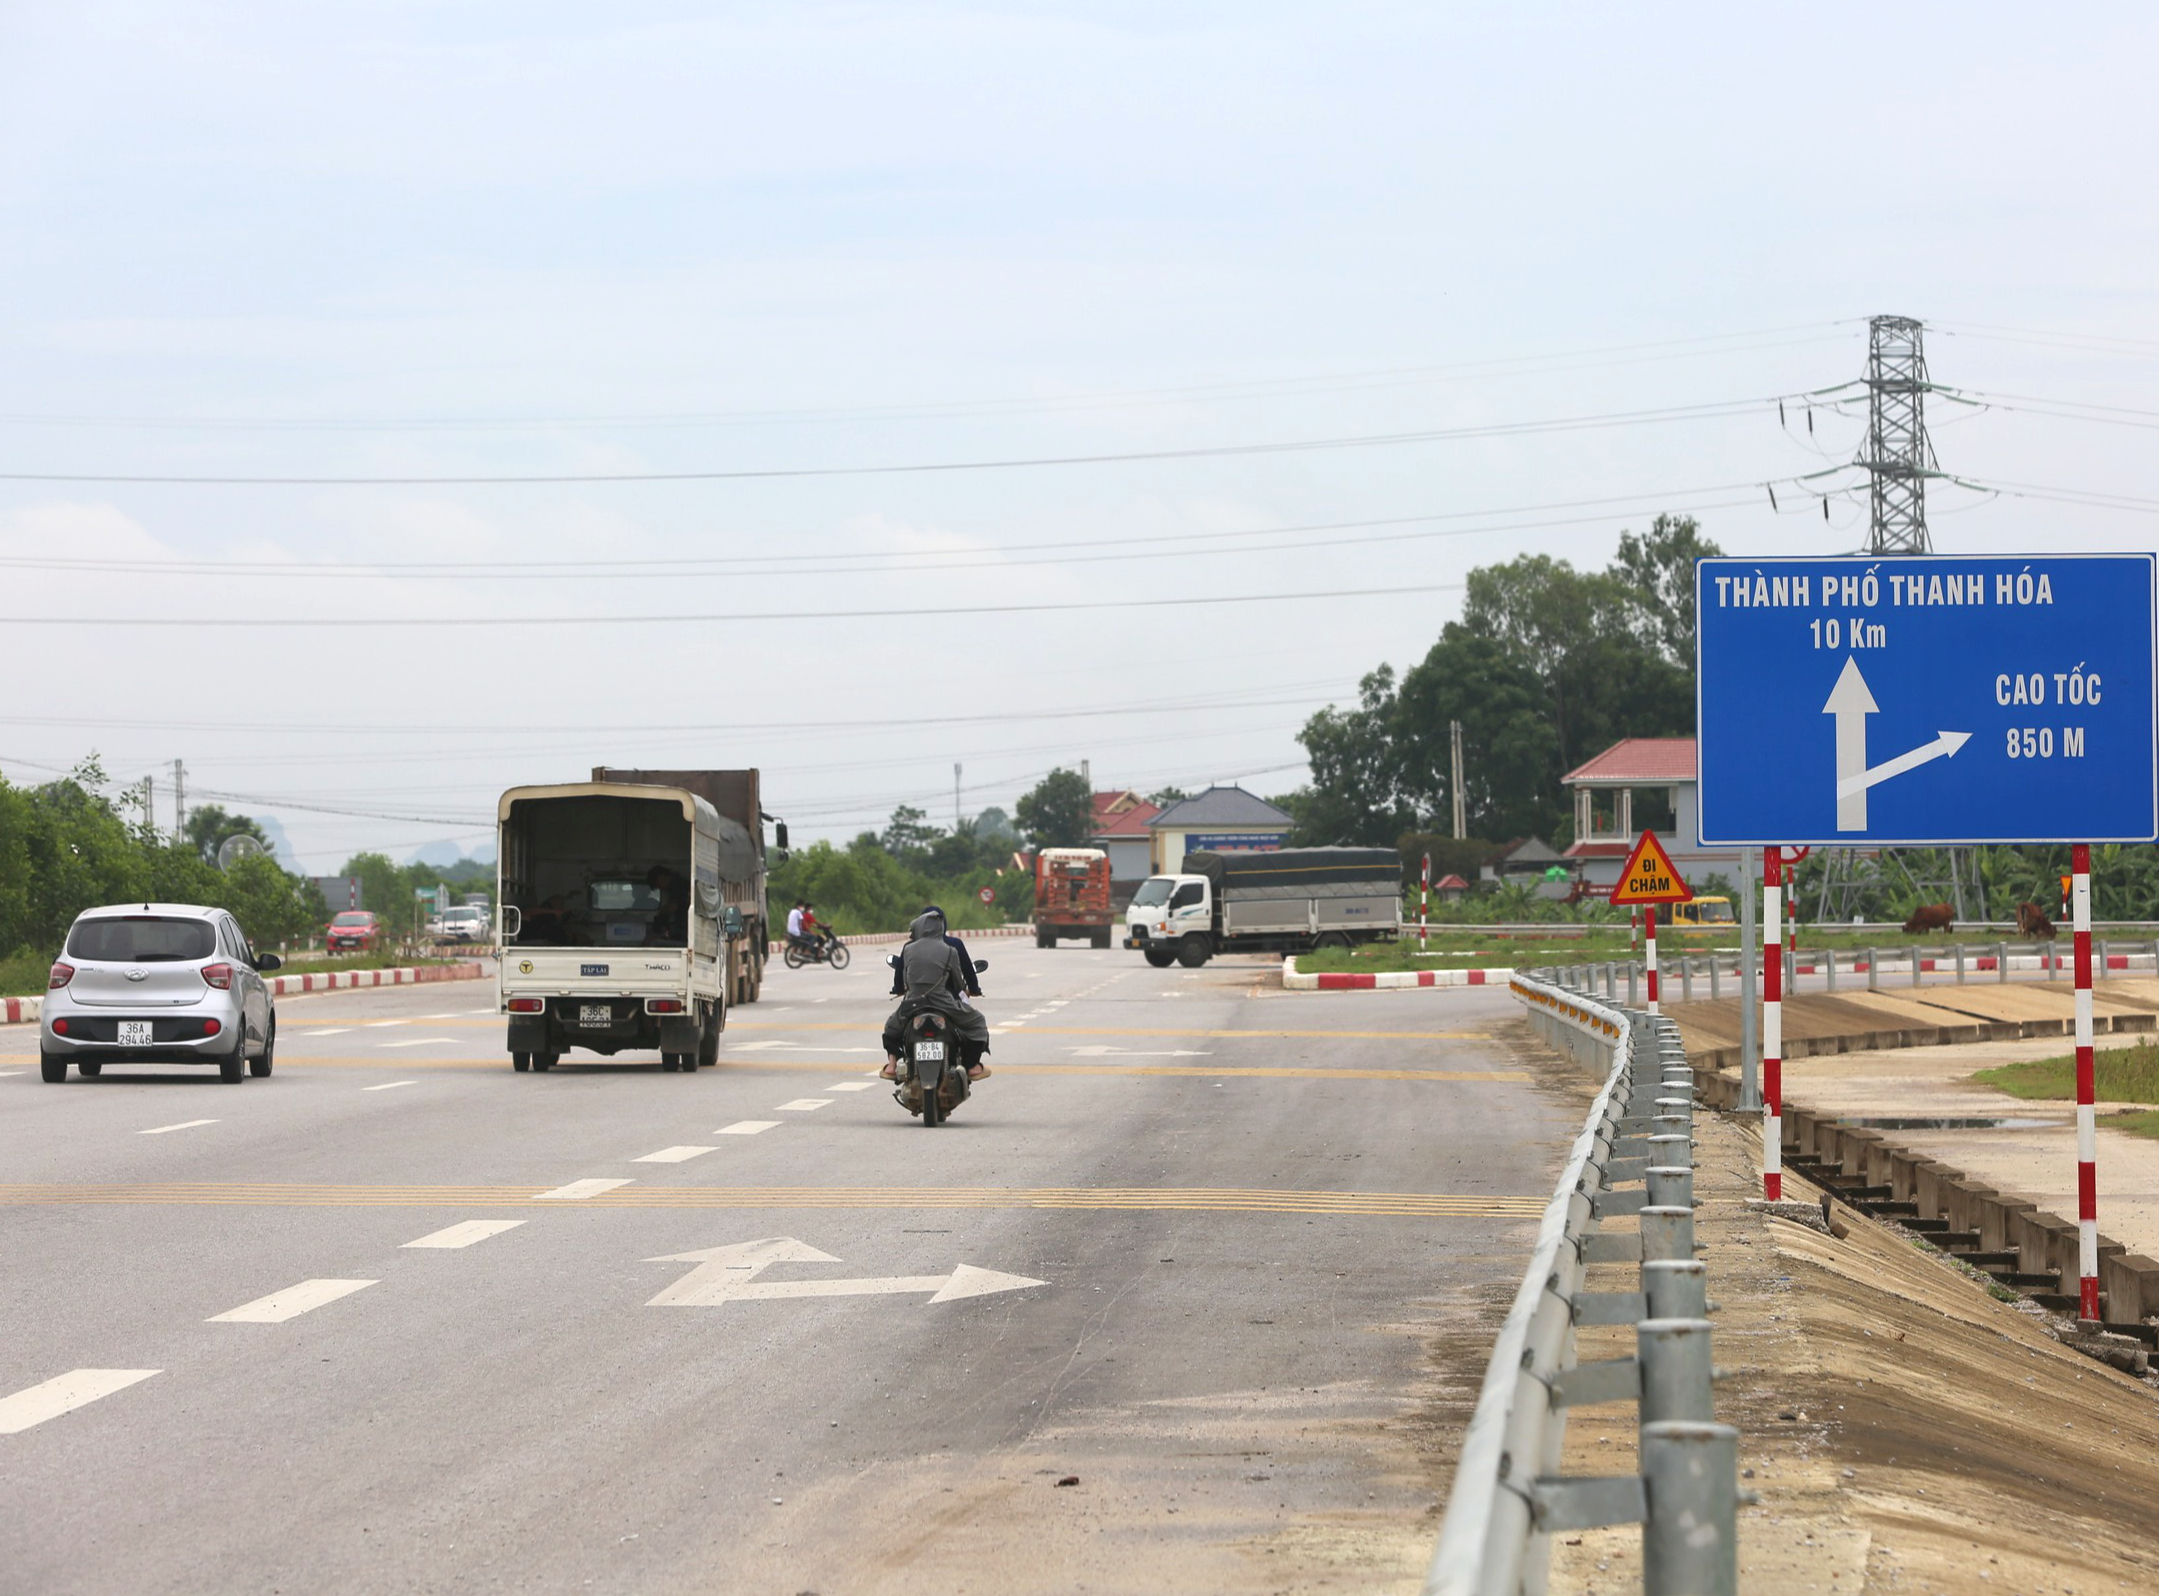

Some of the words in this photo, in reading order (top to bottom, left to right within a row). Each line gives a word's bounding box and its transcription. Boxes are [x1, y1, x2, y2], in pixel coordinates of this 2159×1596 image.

[1714, 568, 1810, 608] THÀNH
[1822, 563, 1881, 607] PHỐ
[1889, 573, 1984, 606] THANH
[1996, 565, 2054, 605] HÓA
[1810, 617, 1840, 649] 10
[1850, 617, 1886, 649] Km
[1995, 673, 2045, 706] CAO
[2053, 661, 2102, 706] TỐC
[2006, 727, 2054, 759] 850
[2063, 727, 2084, 758] M
[1642, 858, 1657, 873] ĐI
[1629, 875, 1670, 895] CHẬM
[587, 1006, 604, 1016] 36C
[126, 1023, 145, 1034] 36A
[119, 1034, 152, 1045] 294.46
